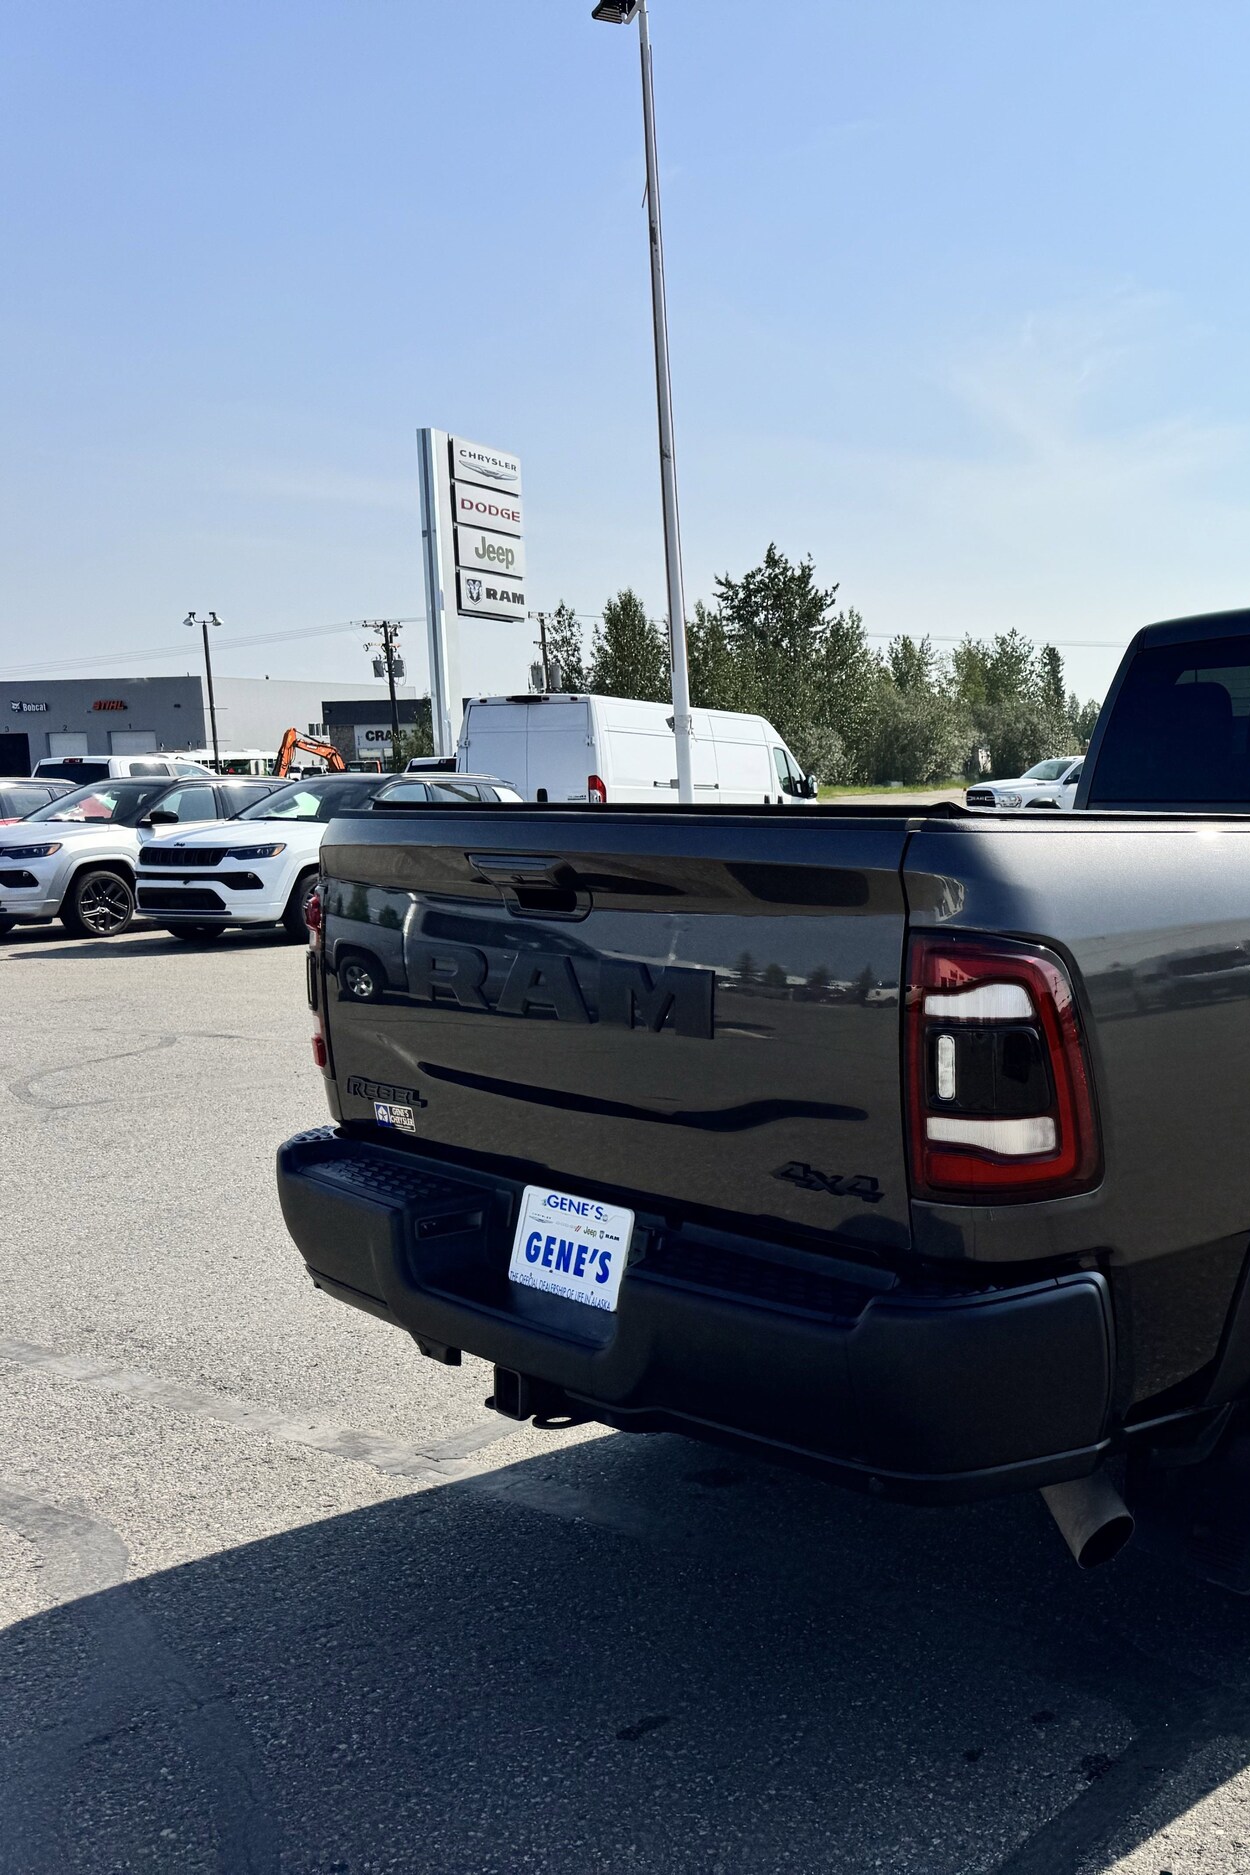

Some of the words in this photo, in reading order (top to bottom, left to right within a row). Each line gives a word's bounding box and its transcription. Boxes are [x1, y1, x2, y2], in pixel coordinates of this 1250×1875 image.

[459, 449, 517, 471] CHRYSLER
[460, 498, 521, 523] DODGE
[474, 536, 515, 570] Jeep
[485, 587, 525, 605] RAM
[22, 702, 47, 712] Bobcat
[92, 700, 125, 711] STIHL
[408, 940, 716, 1039] RAM
[347, 1075, 428, 1108] REBEL
[547, 1194, 604, 1220] GENE'S
[583, 1226, 597, 1238] Jeep
[525, 1231, 612, 1284] GENE'S
